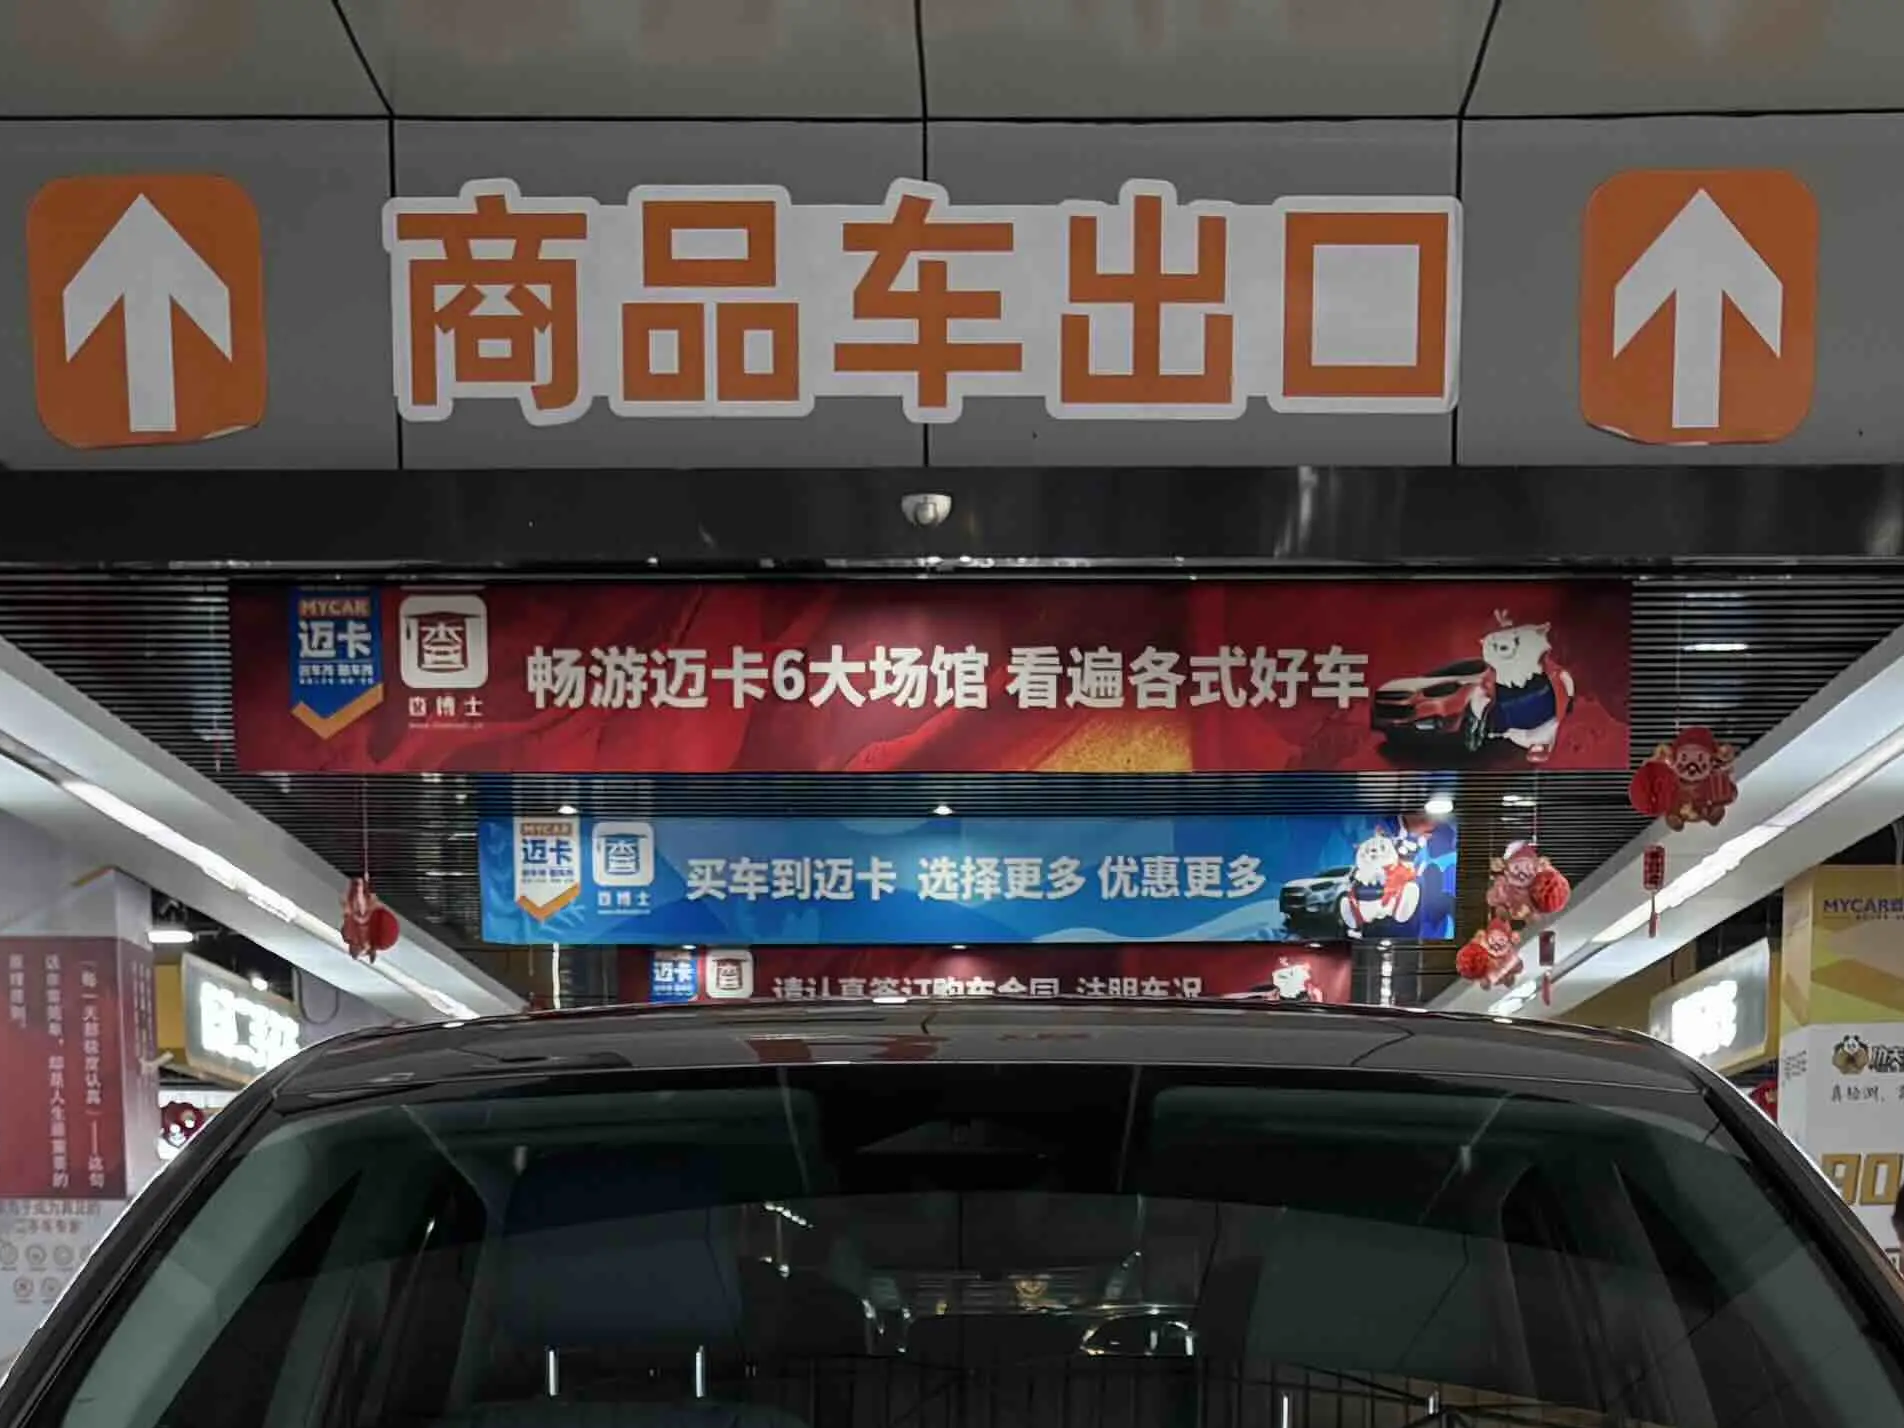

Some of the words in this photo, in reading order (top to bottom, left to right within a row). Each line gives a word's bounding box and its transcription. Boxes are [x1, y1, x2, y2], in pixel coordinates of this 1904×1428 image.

[392, 190, 1454, 414] 商品车出口
[299, 599, 370, 617] MYCAR
[297, 619, 373, 659] 迈卡
[525, 646, 990, 709] 畅游迈卡6大场馆
[1006, 646, 1371, 709] 看遍各式好车
[521, 838, 573, 865] 迈卡
[686, 856, 897, 901] 买车到迈卡
[916, 856, 1087, 901] 选择更多
[1096, 854, 1268, 900] 优惠更多
[652, 961, 696, 983] 迈卡
